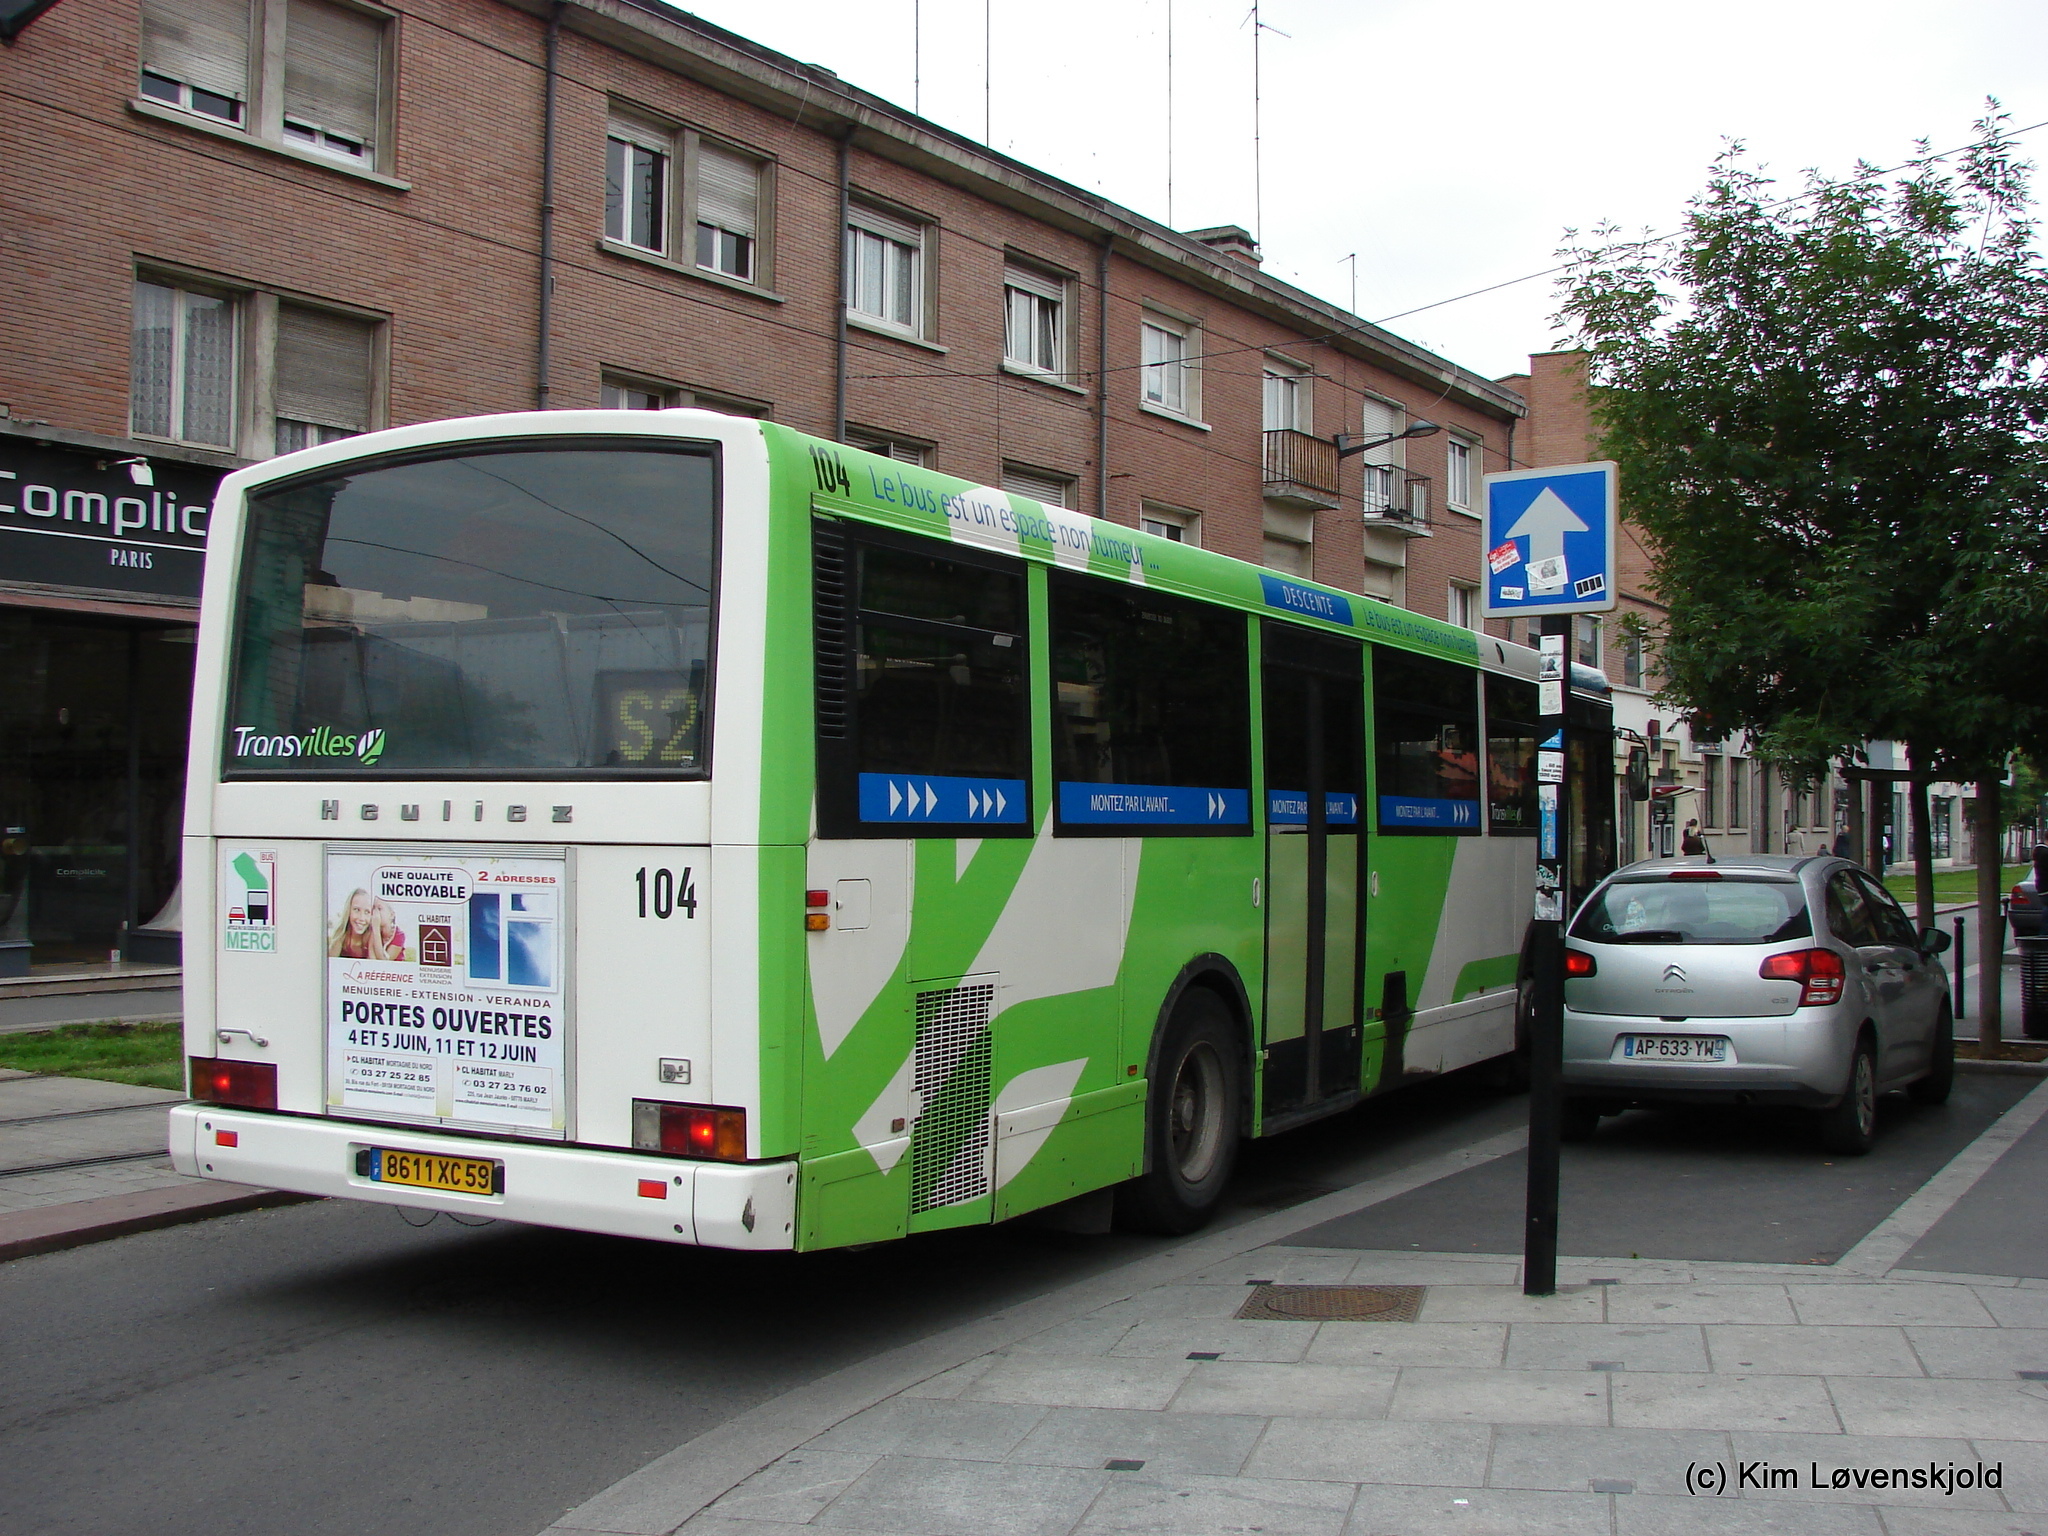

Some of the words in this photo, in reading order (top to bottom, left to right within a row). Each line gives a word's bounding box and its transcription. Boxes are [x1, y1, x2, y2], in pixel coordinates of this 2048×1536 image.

[809, 444, 850, 497] 104
[868, 465, 896, 503] Le
[897, 472, 936, 513] bus
[941, 492, 970, 522] est
[972, 500, 997, 528] un
[1000, 507, 1057, 544] espace
[1059, 524, 1091, 552] non
[1091, 525, 1144, 566] fumeur
[111, 548, 153, 569] PARIS
[1282, 585, 1334, 615] DESCENTE
[1361, 603, 1375, 627] Le
[1372, 605, 1391, 632] bus
[1390, 617, 1404, 635] est
[619, 690, 697, 762] S2
[234, 726, 356, 757] Transvilles
[321, 799, 574, 823] Heuliez
[1091, 795, 1124, 812] MONTEZ
[1125, 796, 1139, 812] PAR
[1272, 800, 1297, 815] MONTEZ
[1297, 801, 1308, 815] PAR
[261, 853, 273, 861] BUS
[381, 871, 404, 880] UNE
[407, 871, 454, 881] QUALITÉ
[477, 870, 489, 882] 2
[494, 875, 557, 884] ADRESSES
[381, 883, 466, 899] INCROYABLE
[635, 866, 697, 920] 104
[418, 914, 426, 923] CL
[426, 914, 452, 924] HABITAT
[364, 969, 414, 984] RÉFÉRENCE
[342, 985, 403, 998] MENUISERIE
[411, 990, 474, 1003] EXTENSION
[486, 996, 552, 1009] VERANDA
[342, 1000, 425, 1029] PORTES
[432, 1007, 552, 1040] OUVERTES
[349, 1030, 357, 1044] 4
[361, 1030, 378, 1047] ET
[381, 1032, 390, 1048] 5
[393, 1034, 432, 1055] JUIN,
[435, 1038, 451, 1054] 11
[457, 1040, 475, 1056] ET
[480, 1042, 497, 1059] 12
[501, 1044, 537, 1063] JUIN
[1635, 1039, 1714, 1056] AP-633-YW
[360, 1057, 385, 1066] HABITAT
[361, 1069, 373, 1077] 03
[375, 1070, 387, 1078] 27
[404, 1073, 415, 1081] 22
[418, 1074, 430, 1082] 85
[461, 1066, 470, 1074] CL
[471, 1067, 497, 1076] HABITAT
[498, 1070, 515, 1078] MARLY
[473, 1080, 486, 1088] 03
[488, 1081, 501, 1089] 27
[503, 1083, 516, 1091] 23
[519, 1084, 531, 1092] 76
[534, 1086, 547, 1094] 02
[387, 1154, 432, 1182] 8611
[438, 1159, 461, 1186] XC
[465, 1163, 489, 1189] 59
